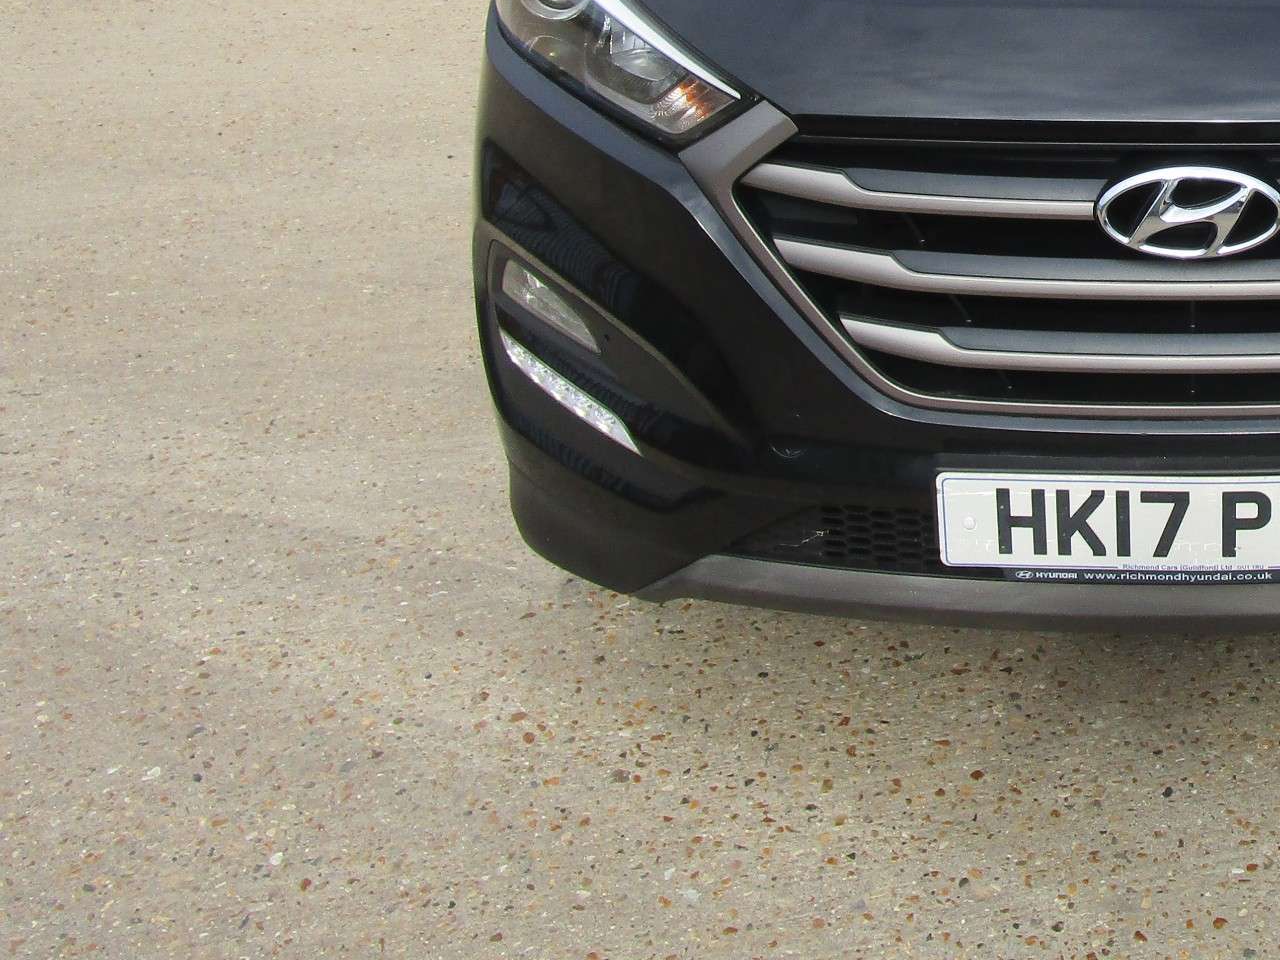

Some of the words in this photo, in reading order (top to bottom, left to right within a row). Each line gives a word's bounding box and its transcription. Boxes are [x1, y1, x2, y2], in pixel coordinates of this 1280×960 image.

[995, 488, 1191, 558] HK17
[1035, 571, 1078, 579] HYUNDAI
[1083, 571, 1273, 582] www.richmondhyundai.co.uk
